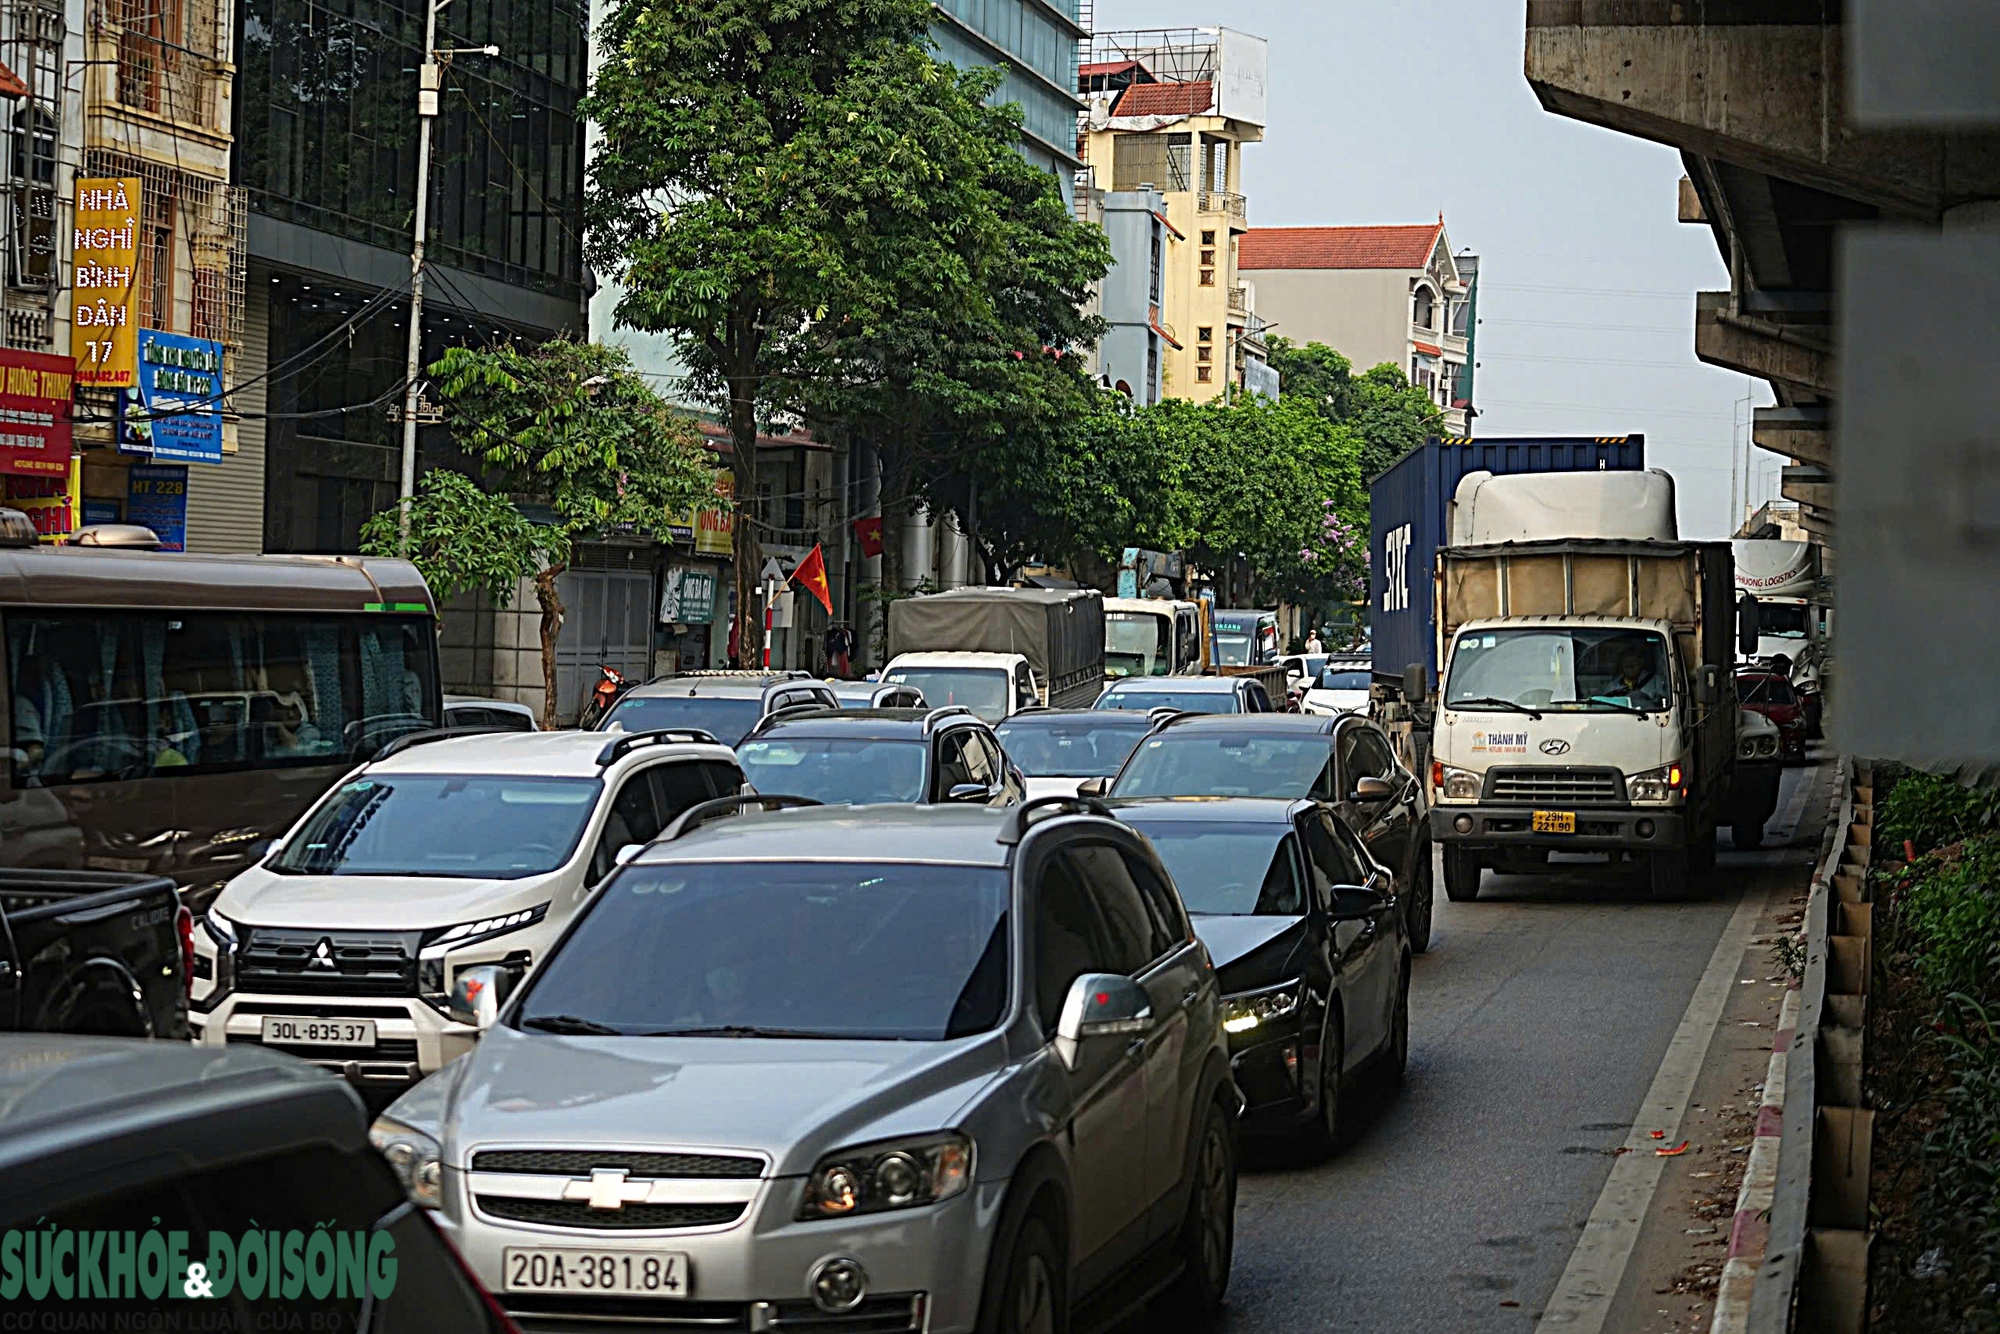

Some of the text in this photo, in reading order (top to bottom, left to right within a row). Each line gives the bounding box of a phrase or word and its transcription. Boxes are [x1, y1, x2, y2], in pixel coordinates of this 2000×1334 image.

[80, 181, 130, 211] NHÀ
[74, 216, 136, 250] NGHỈ
[76, 259, 130, 288] BÌNH
[77, 298, 127, 327] DÂN
[85, 341, 113, 362] 17
[156, 481, 184, 495] 228
[1764, 567, 1798, 587] LOGISTICS
[1488, 731, 1514, 745] THÀNH
[1544, 812, 1564, 822] 29H
[271, 1022, 366, 1042] 30L-835.37
[511, 1253, 679, 1291] 20A-381.84
